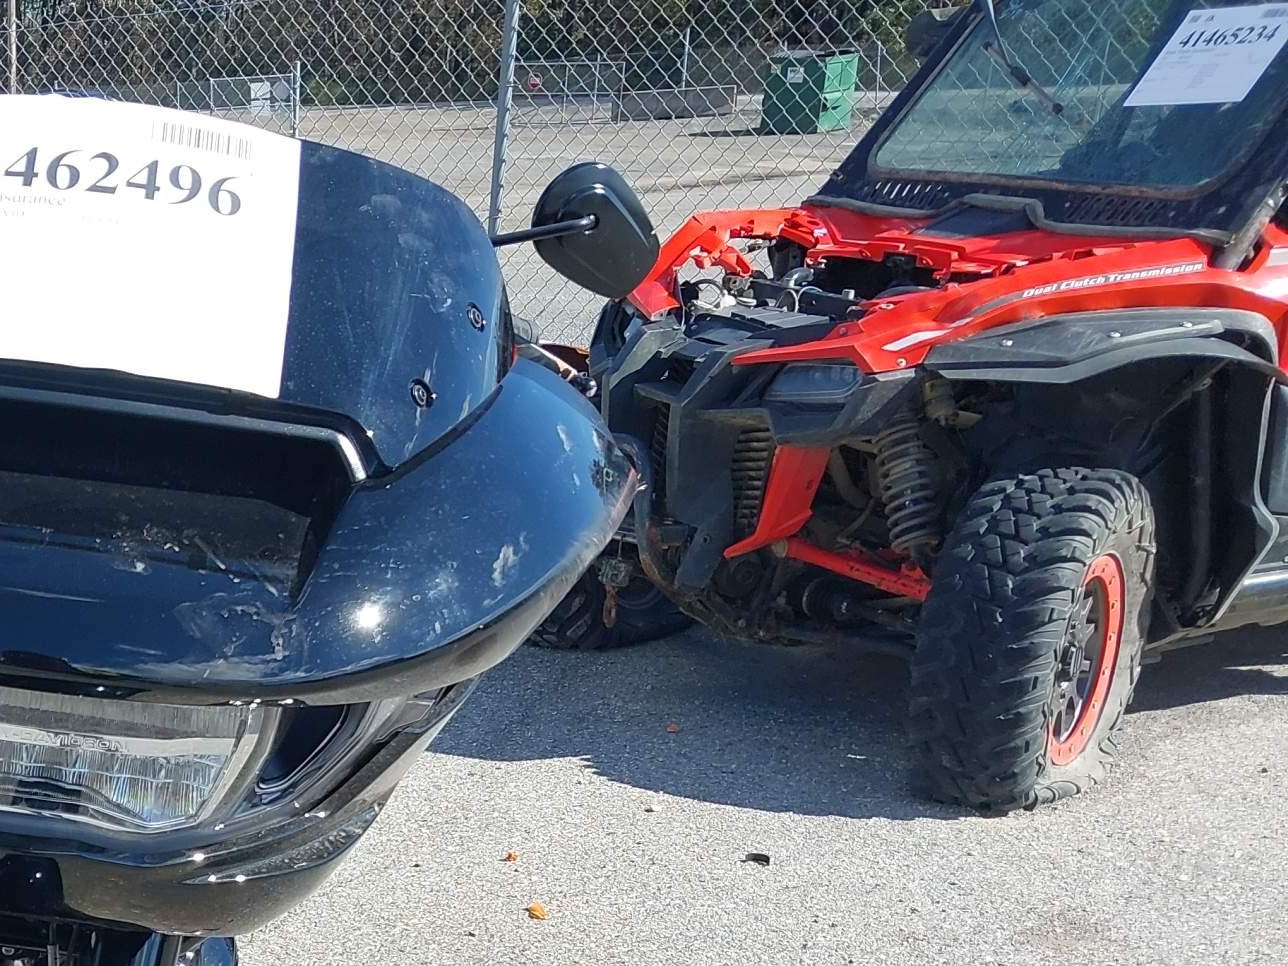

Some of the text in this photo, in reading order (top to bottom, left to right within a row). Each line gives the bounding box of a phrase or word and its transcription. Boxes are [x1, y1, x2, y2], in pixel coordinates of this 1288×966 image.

[1179, 24, 1282, 48] 41465234
[1022, 263, 1203, 298] Dual Clutch Transmission
